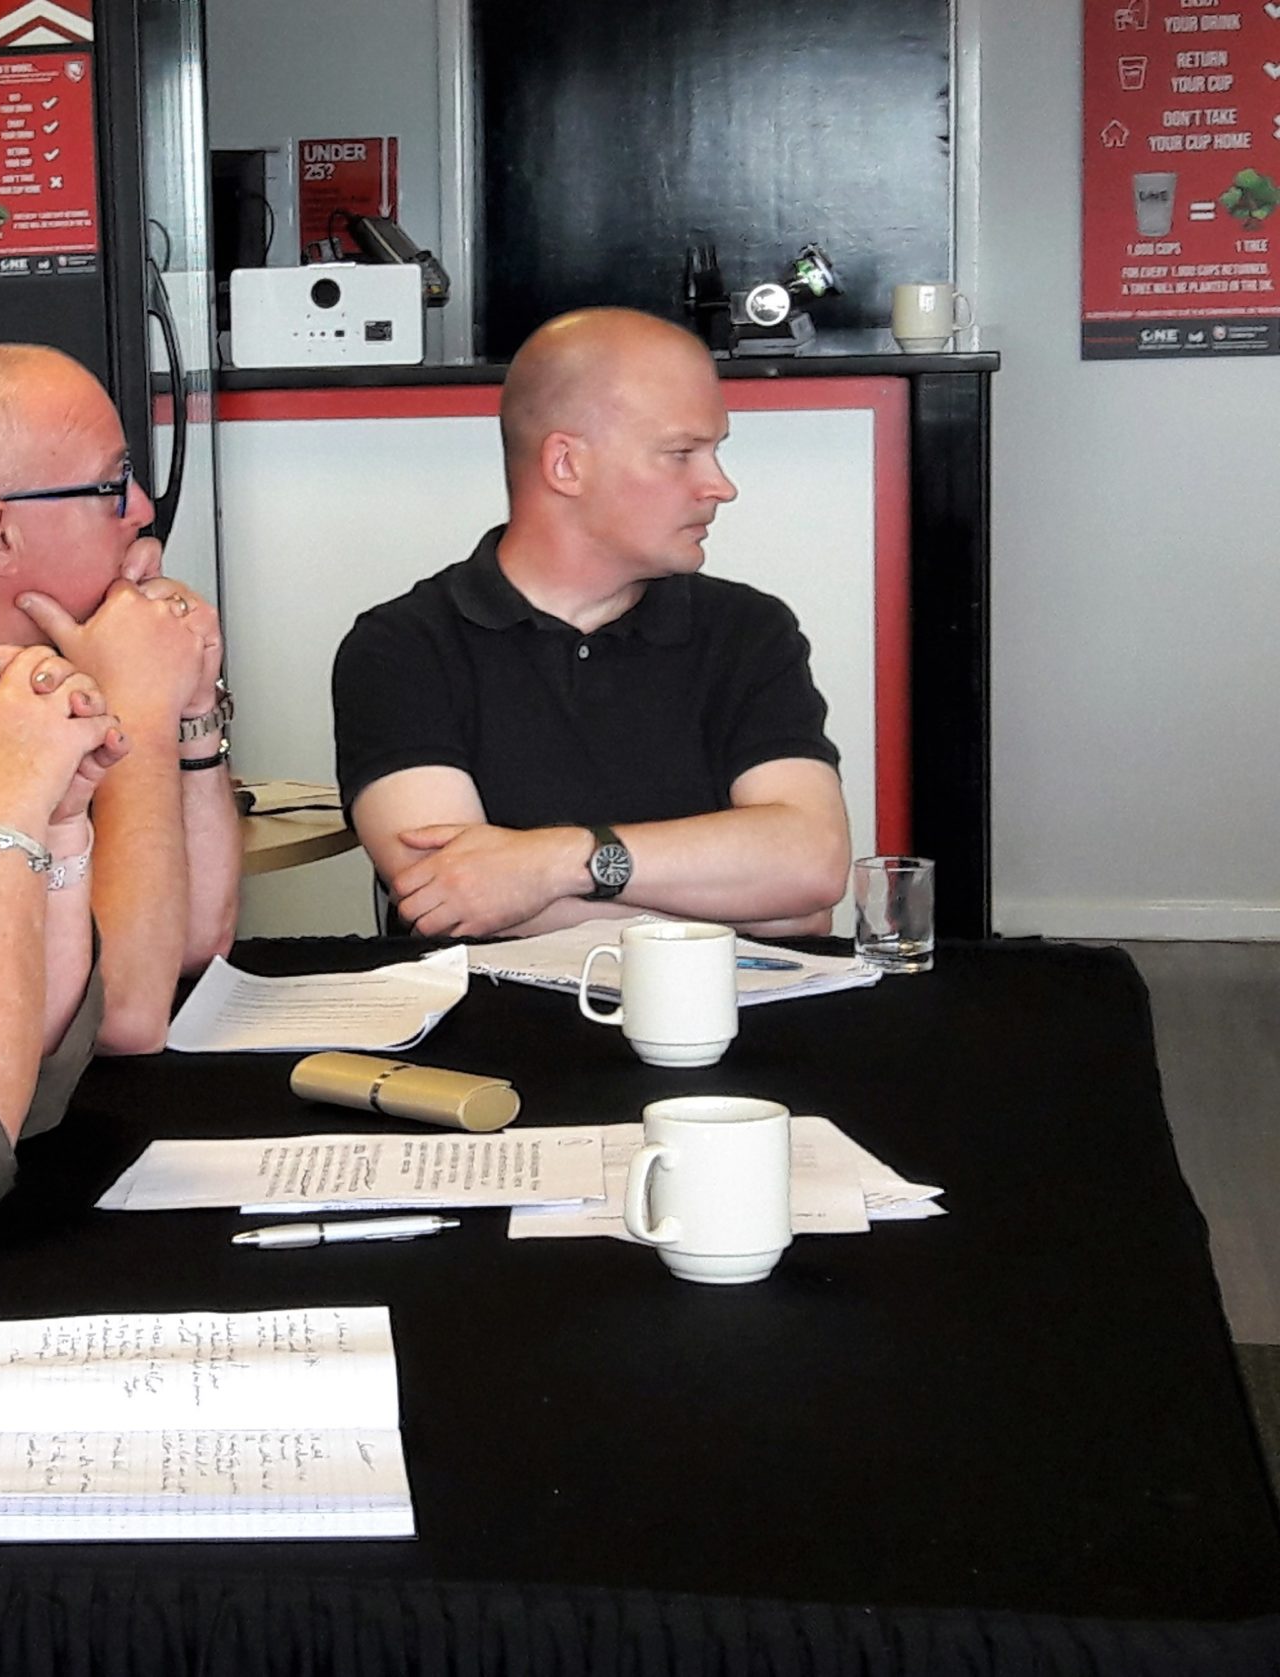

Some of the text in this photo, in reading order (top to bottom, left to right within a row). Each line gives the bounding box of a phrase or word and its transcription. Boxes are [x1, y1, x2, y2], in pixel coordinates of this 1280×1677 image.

[1165, 13, 1240, 32] YOUR DRINK
[1177, 51, 1228, 68] RETURN
[1171, 74, 1234, 93] YOUR CUP
[1163, 108, 1238, 127] DON'T TAKE
[1147, 132, 1252, 151] YOUR CUP HOME
[304, 143, 367, 162] UNDER
[304, 163, 336, 181] 25?
